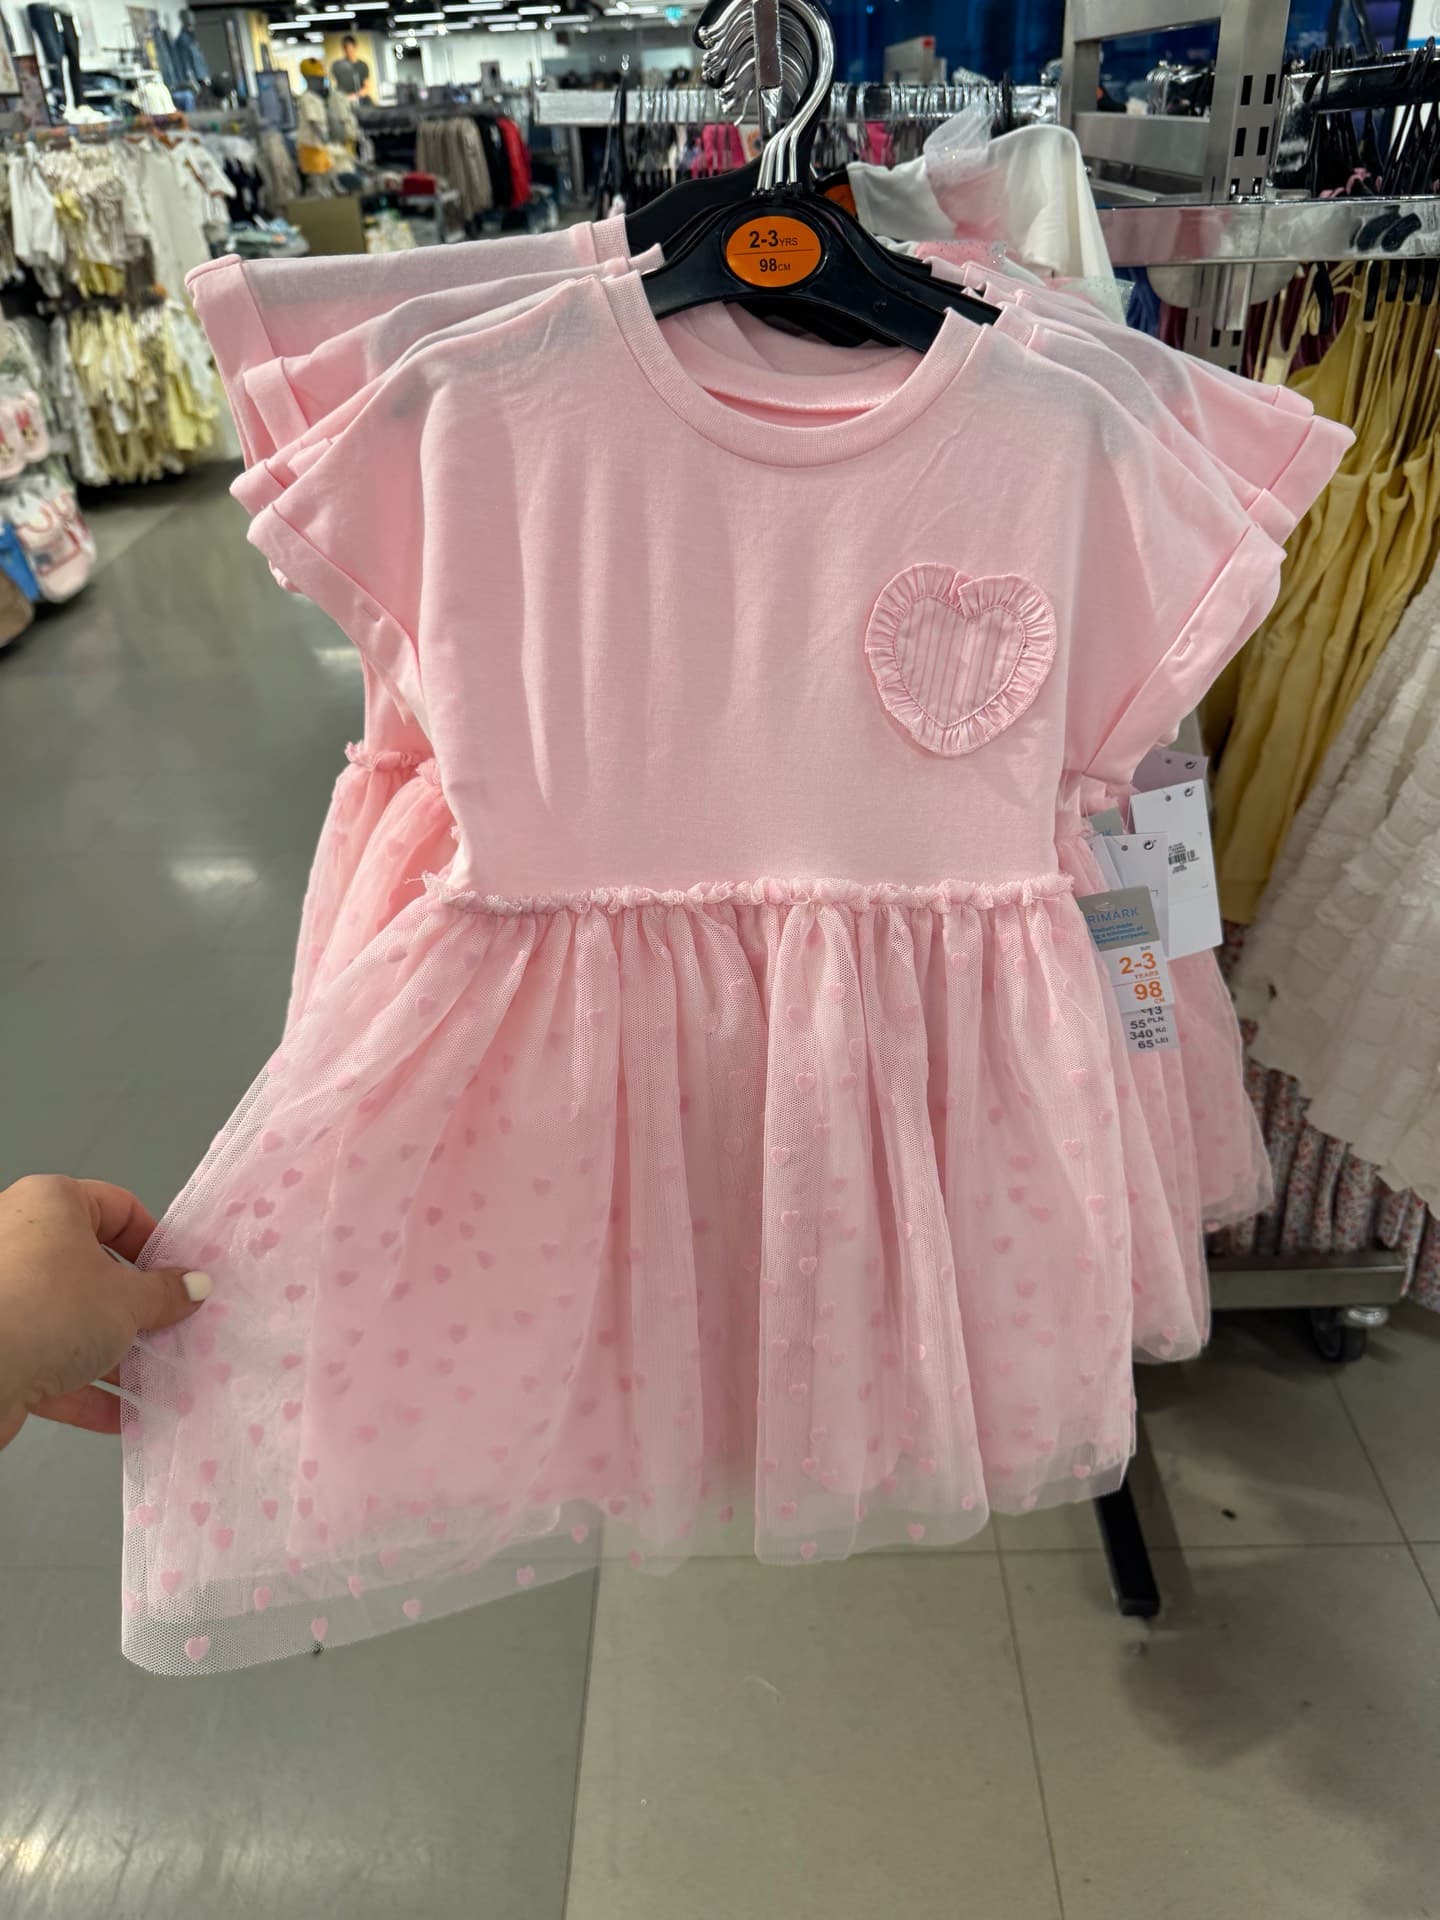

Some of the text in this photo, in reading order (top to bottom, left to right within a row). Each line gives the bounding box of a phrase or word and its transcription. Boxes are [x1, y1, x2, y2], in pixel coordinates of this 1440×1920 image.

[749, 230, 798, 248] 2-3 YRS
[759, 257, 791, 272] 98 CM
[1087, 907, 1139, 924] RIMARK
[1119, 951, 1156, 975] 2-3
[1134, 970, 1159, 979] YEARS
[1134, 981, 1163, 1001] 98
[1130, 1019, 1146, 1030] 55
[1129, 1029, 1153, 1040] 340
[1138, 1040, 1154, 1049] 65
